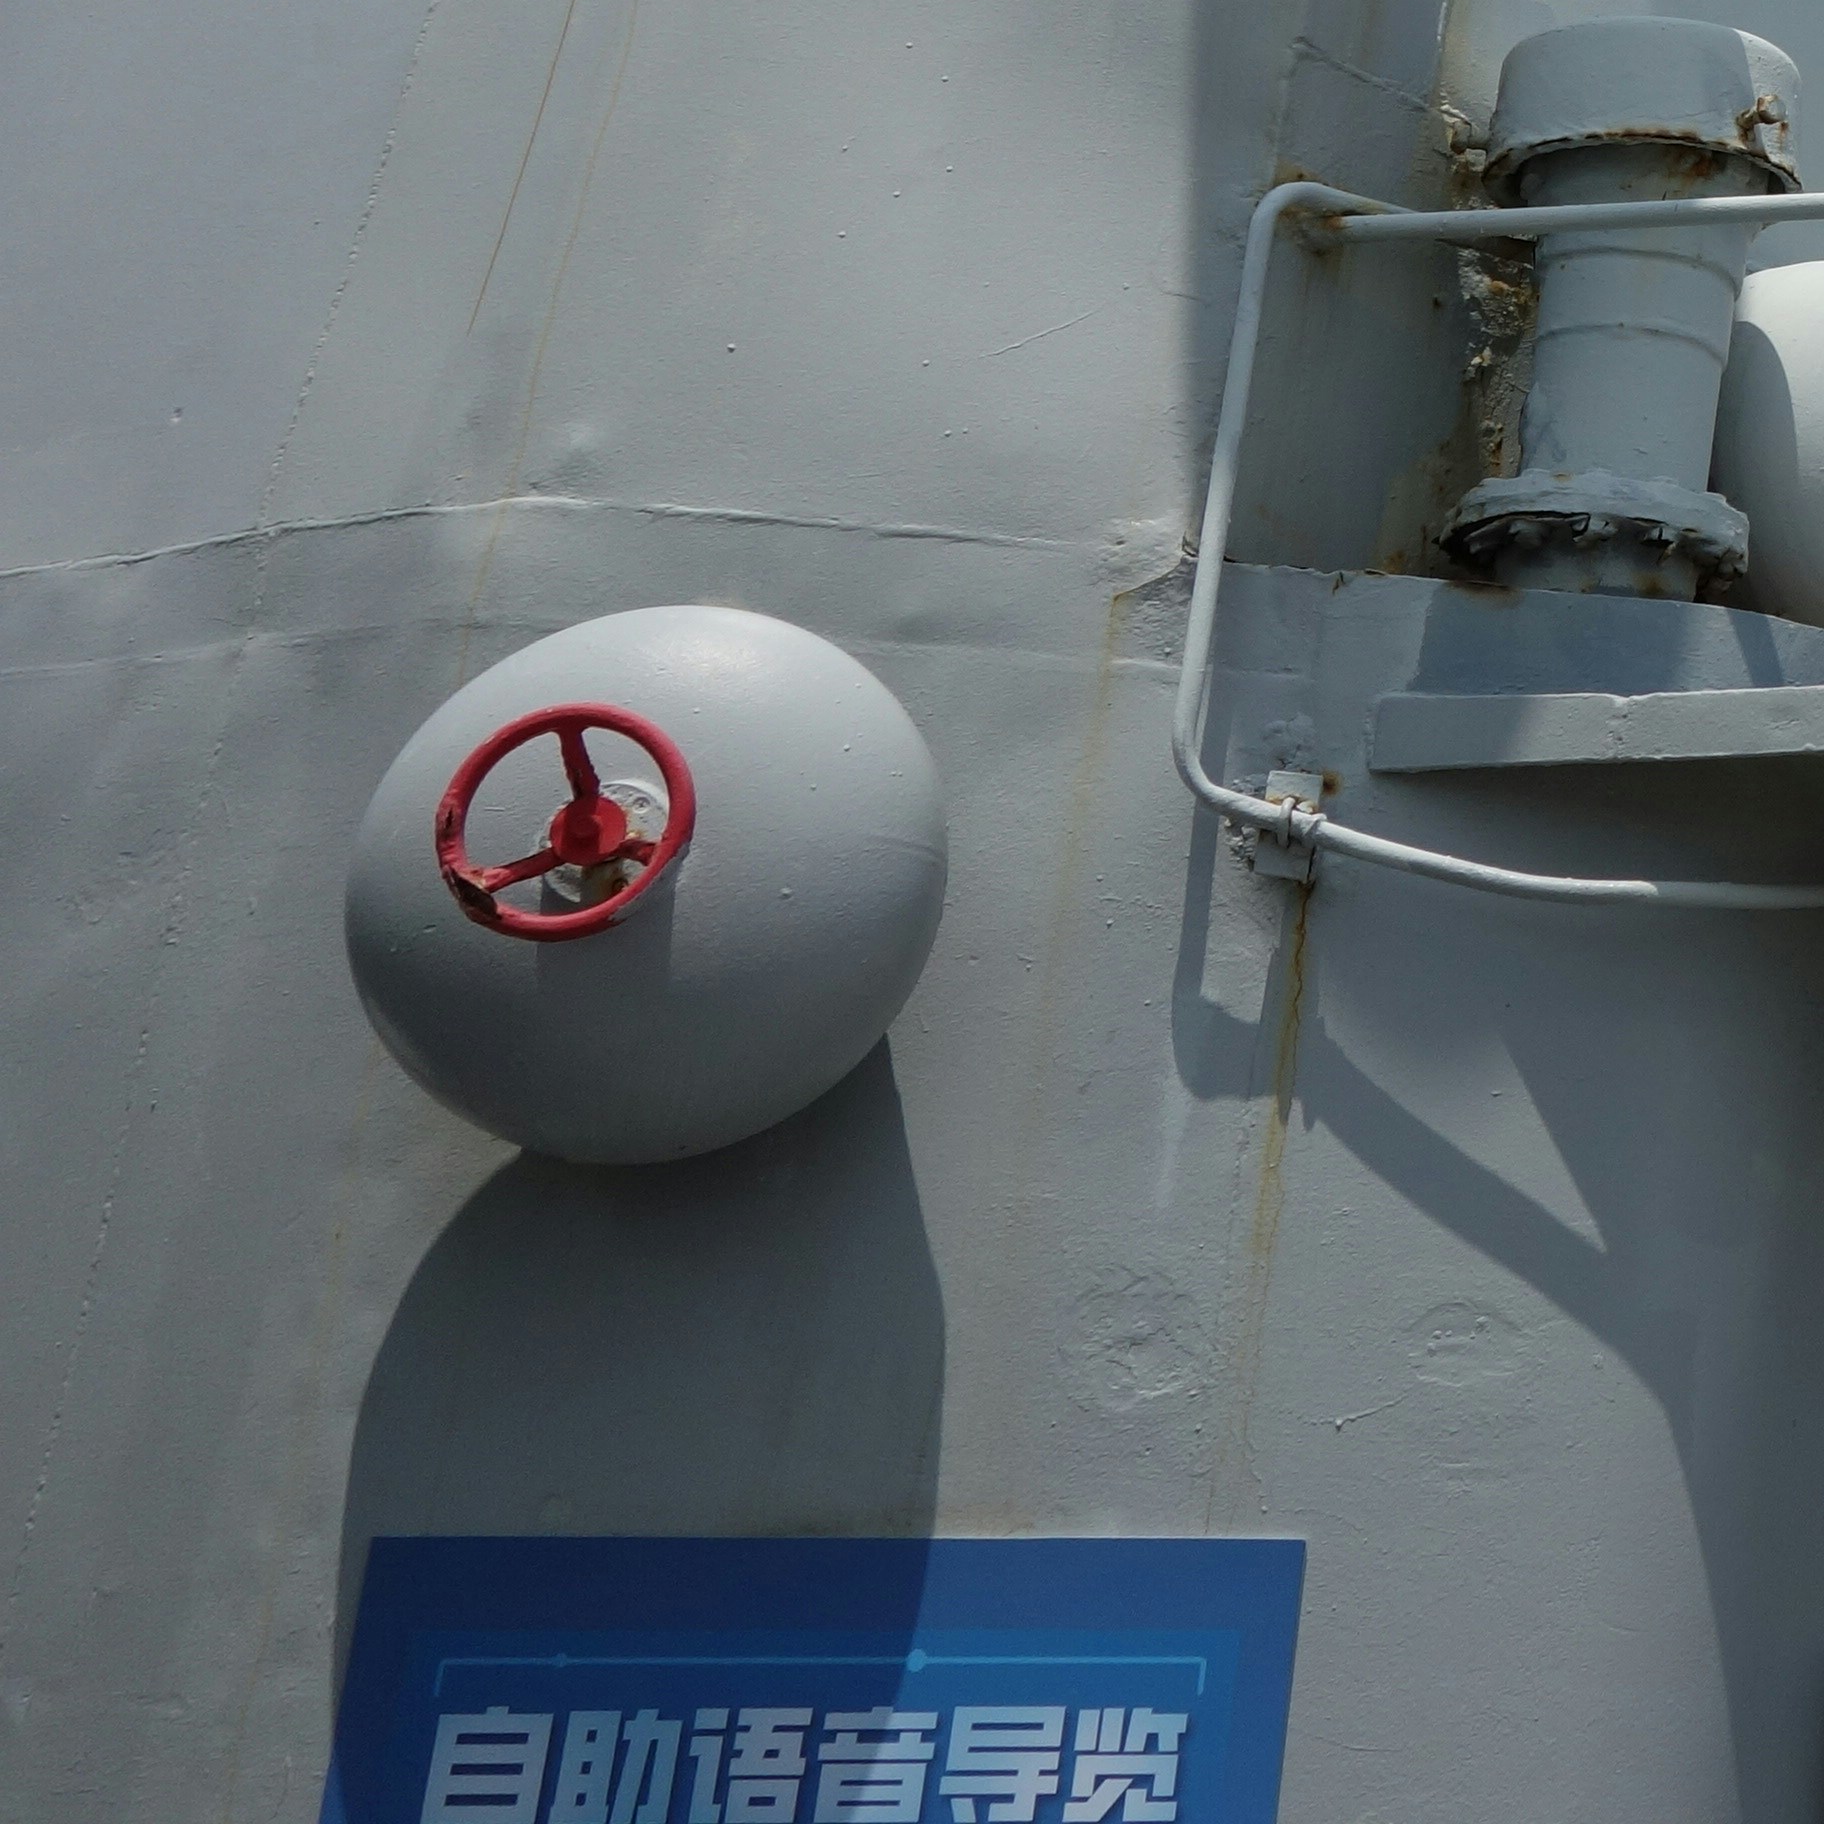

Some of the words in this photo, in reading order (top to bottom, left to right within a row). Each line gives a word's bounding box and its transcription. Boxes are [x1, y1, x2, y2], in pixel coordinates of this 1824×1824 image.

[422, 1705, 1188, 1824] 自助语音导览
